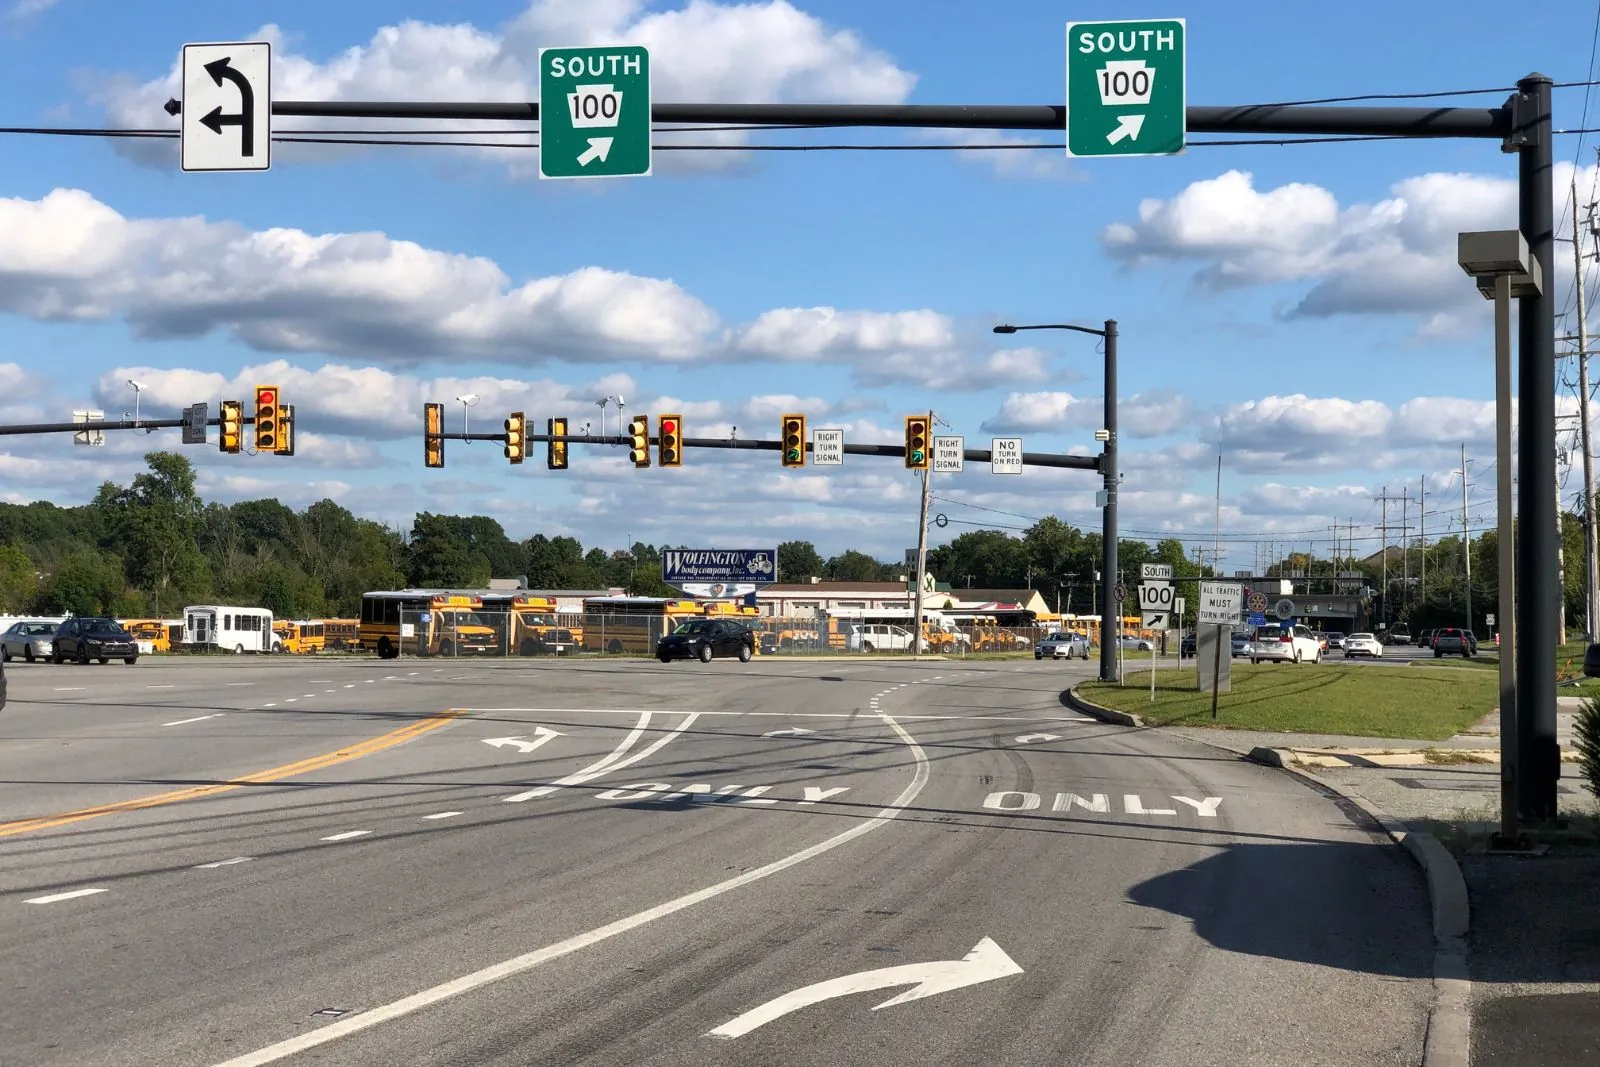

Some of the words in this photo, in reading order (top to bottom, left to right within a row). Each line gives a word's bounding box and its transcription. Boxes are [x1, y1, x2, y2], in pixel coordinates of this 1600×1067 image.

[1079, 30, 1174, 54] SOUTH
[550, 55, 640, 78] SOUTH
[1102, 70, 1149, 97] 100
[573, 93, 617, 120] 100
[818, 433, 838, 441] RIGHT
[939, 440, 958, 448] RIGHT
[1000, 441, 1015, 450] NO
[816, 454, 840, 462] SIGNAL
[940, 450, 958, 458] TURN
[936, 460, 960, 469] SIGNAL
[666, 551, 747, 575] WOLFINGTON
[681, 565, 698, 576] body
[1144, 566, 1170, 577] SOUTH
[1141, 587, 1171, 604] 100
[1203, 587, 1213, 595] ALL
[1216, 587, 1240, 596] TRAFFIC
[1209, 599, 1231, 608] MUST
[1201, 611, 1217, 619] TURN
[1220, 612, 1239, 620] RIGHT
[594, 783, 851, 805] ONLY
[983, 791, 1223, 817] ONLY
